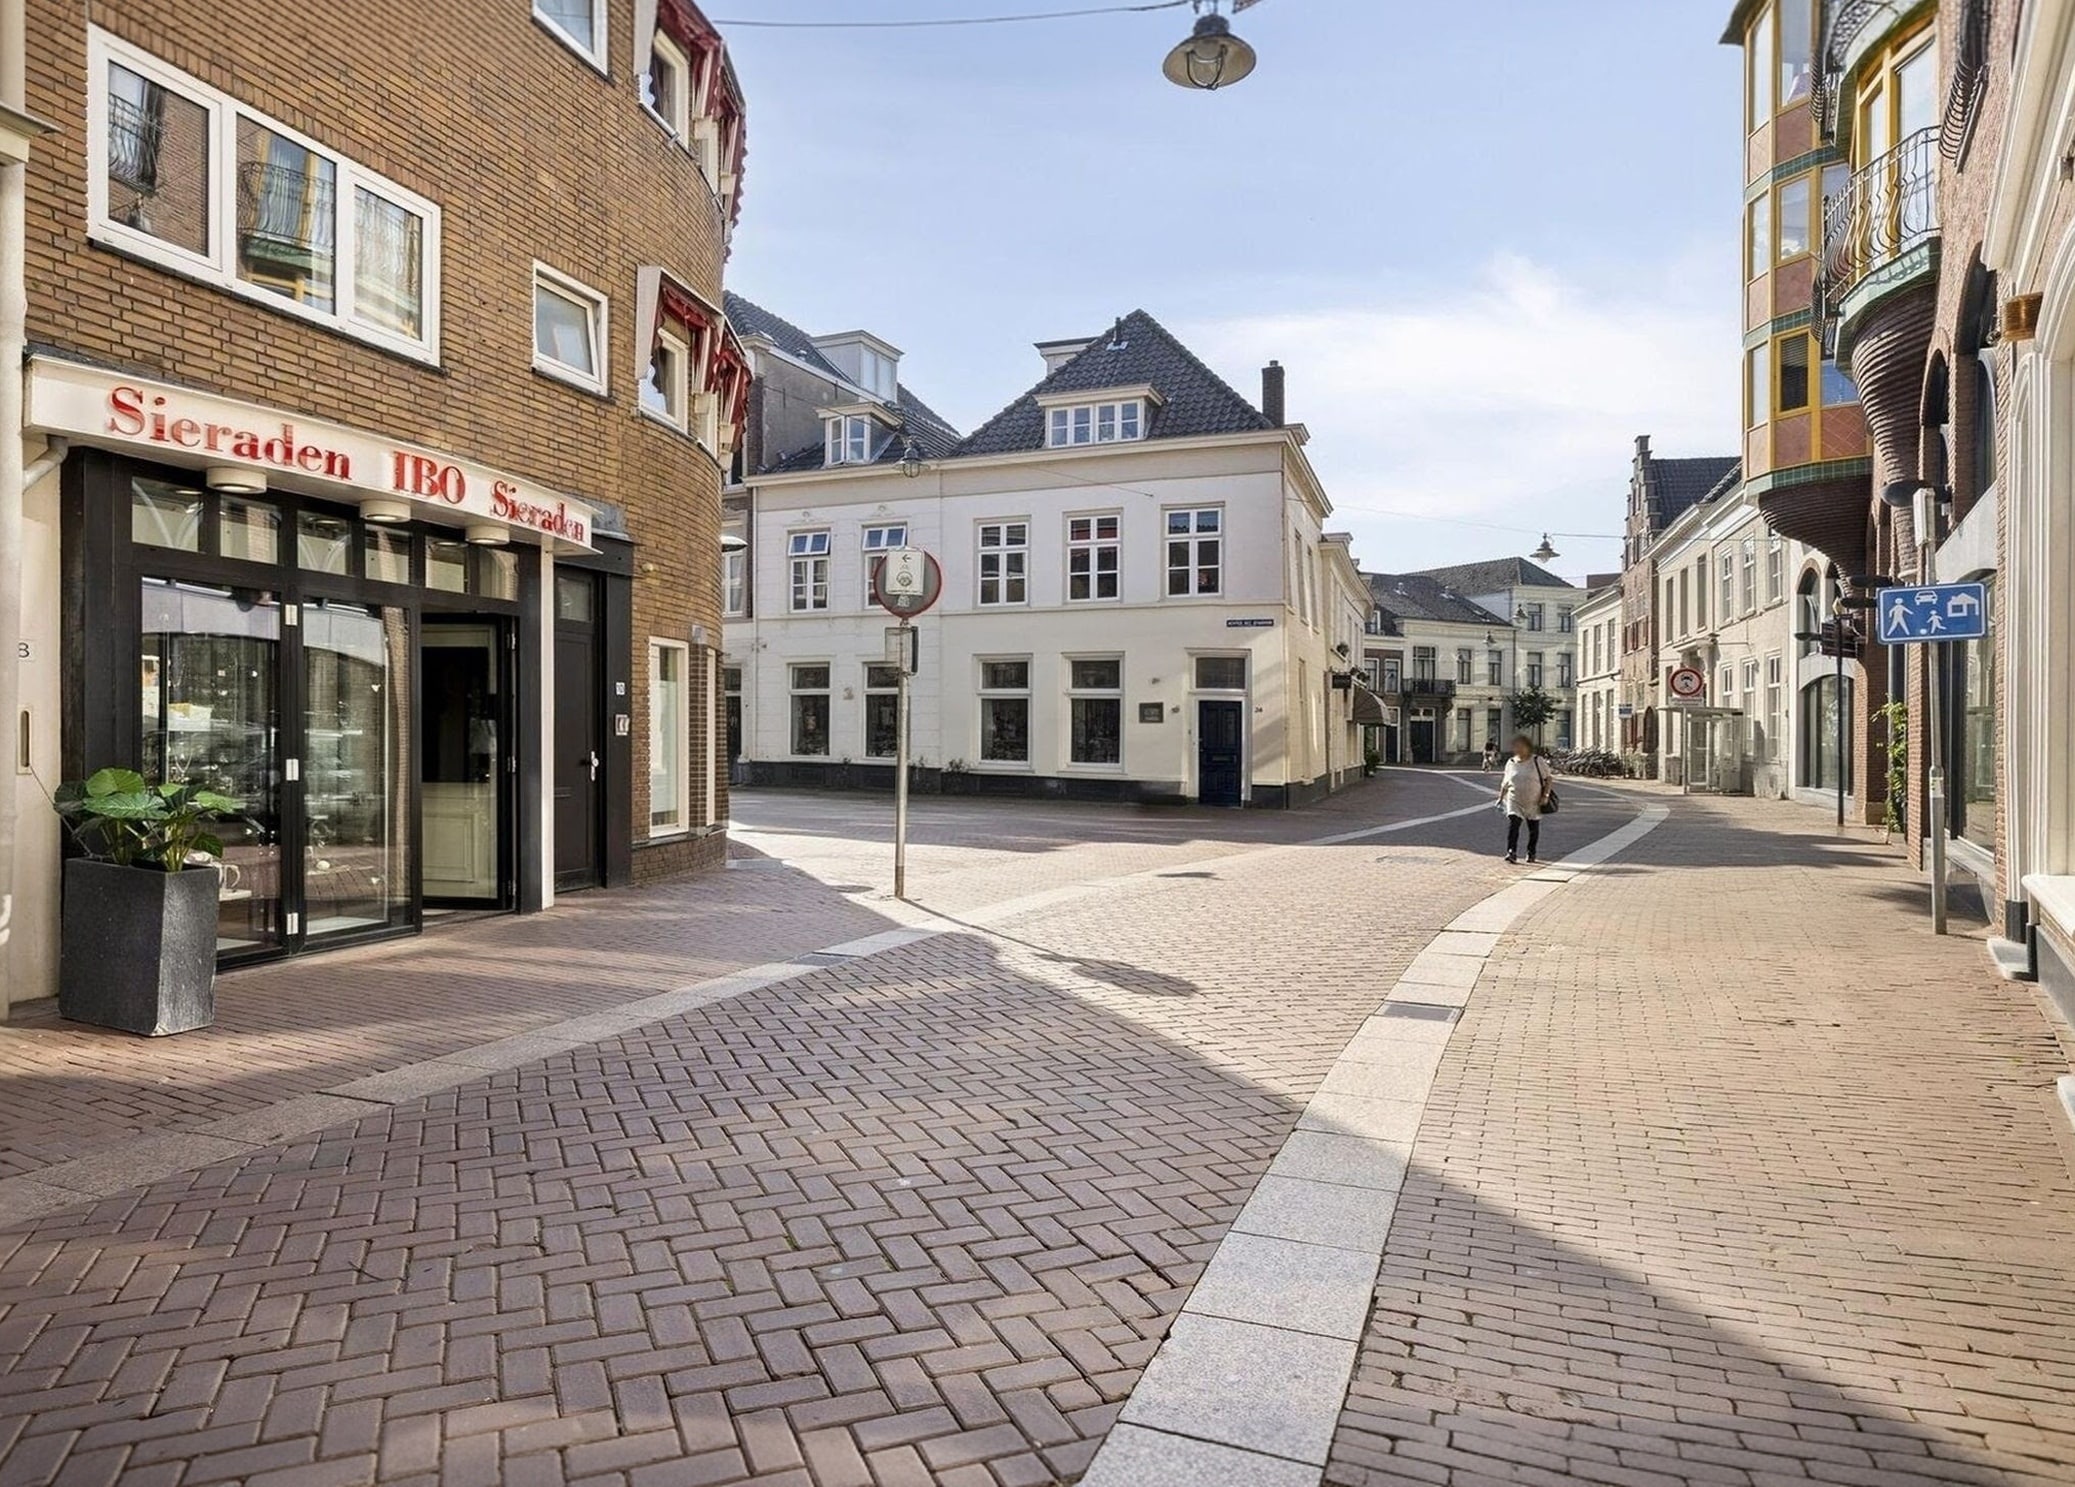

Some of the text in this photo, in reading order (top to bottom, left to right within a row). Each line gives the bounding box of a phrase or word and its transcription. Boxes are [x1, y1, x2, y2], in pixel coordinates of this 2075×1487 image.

[108, 386, 585, 542] Sieraden IBO Sieraden
